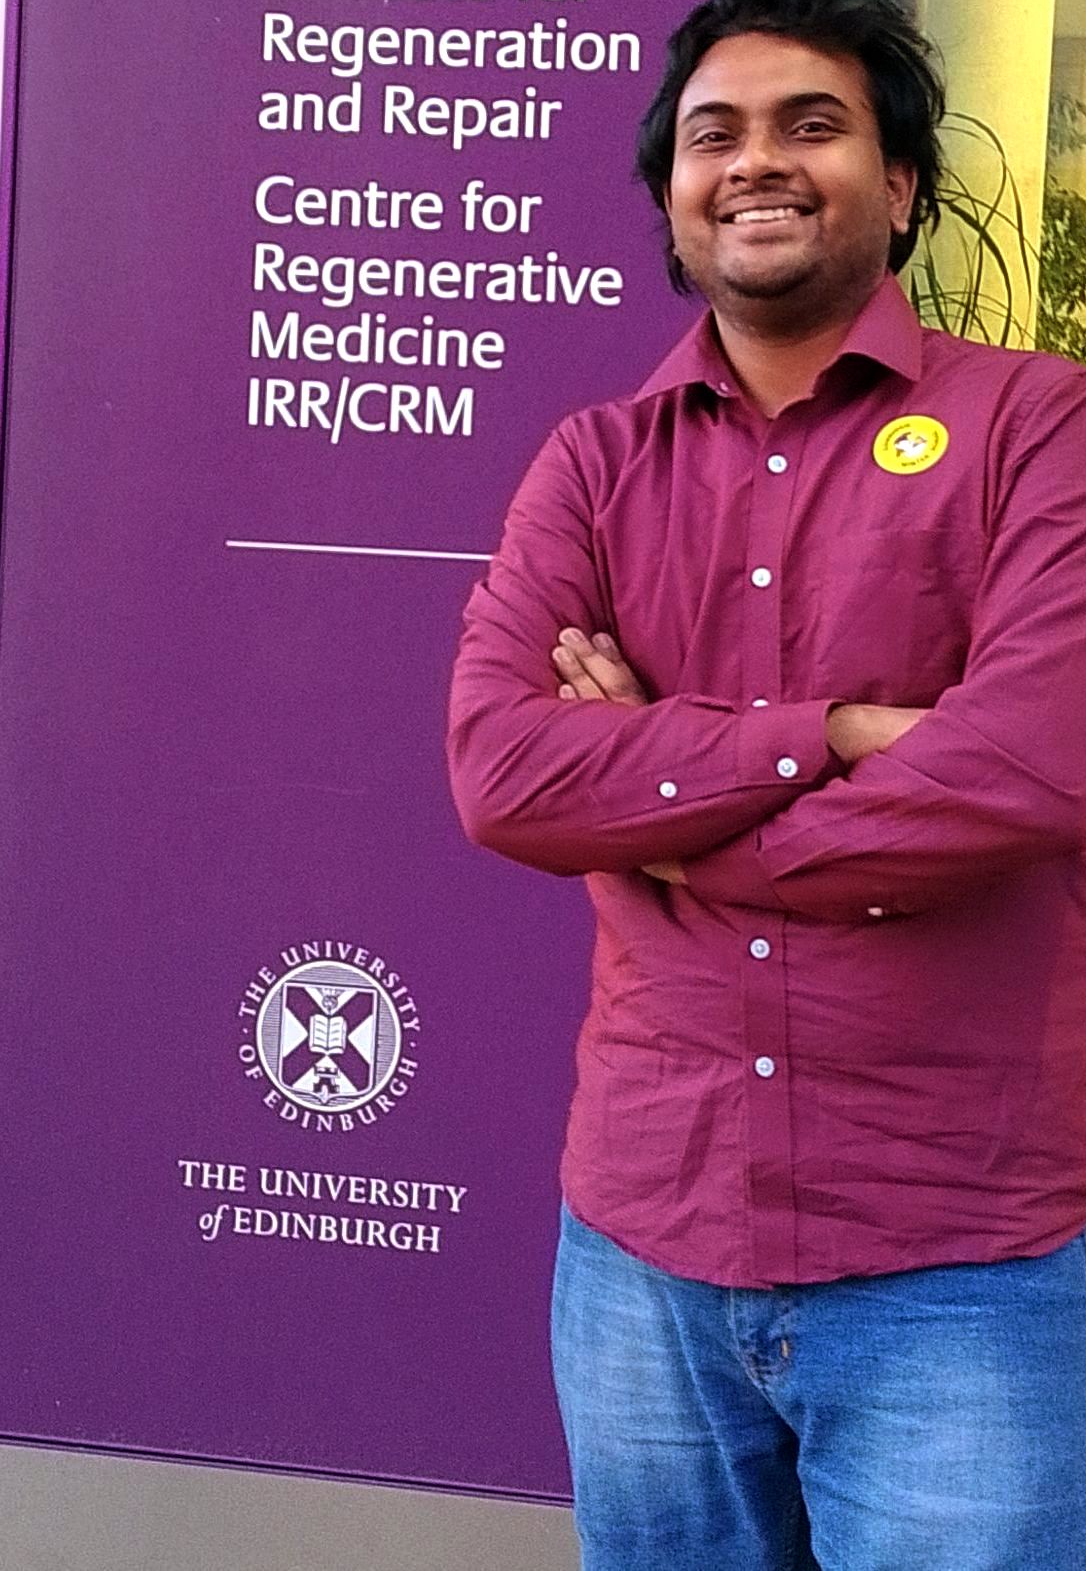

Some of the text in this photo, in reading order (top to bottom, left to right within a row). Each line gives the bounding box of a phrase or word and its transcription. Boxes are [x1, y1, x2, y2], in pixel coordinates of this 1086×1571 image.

[263, 12, 640, 78] Regeneration
[258, 81, 563, 150] and Repair
[255, 175, 543, 233] Centre for
[254, 242, 623, 308] Regenerative
[250, 310, 505, 369] Medicine
[248, 376, 474, 445] IRR/CRM
[238, 939, 421, 1132] THE UNIVERSITY OF EDINBURGH
[178, 1160, 468, 1213] THE UNIVERSITY
[199, 1204, 441, 1253] of EDINBURGH
